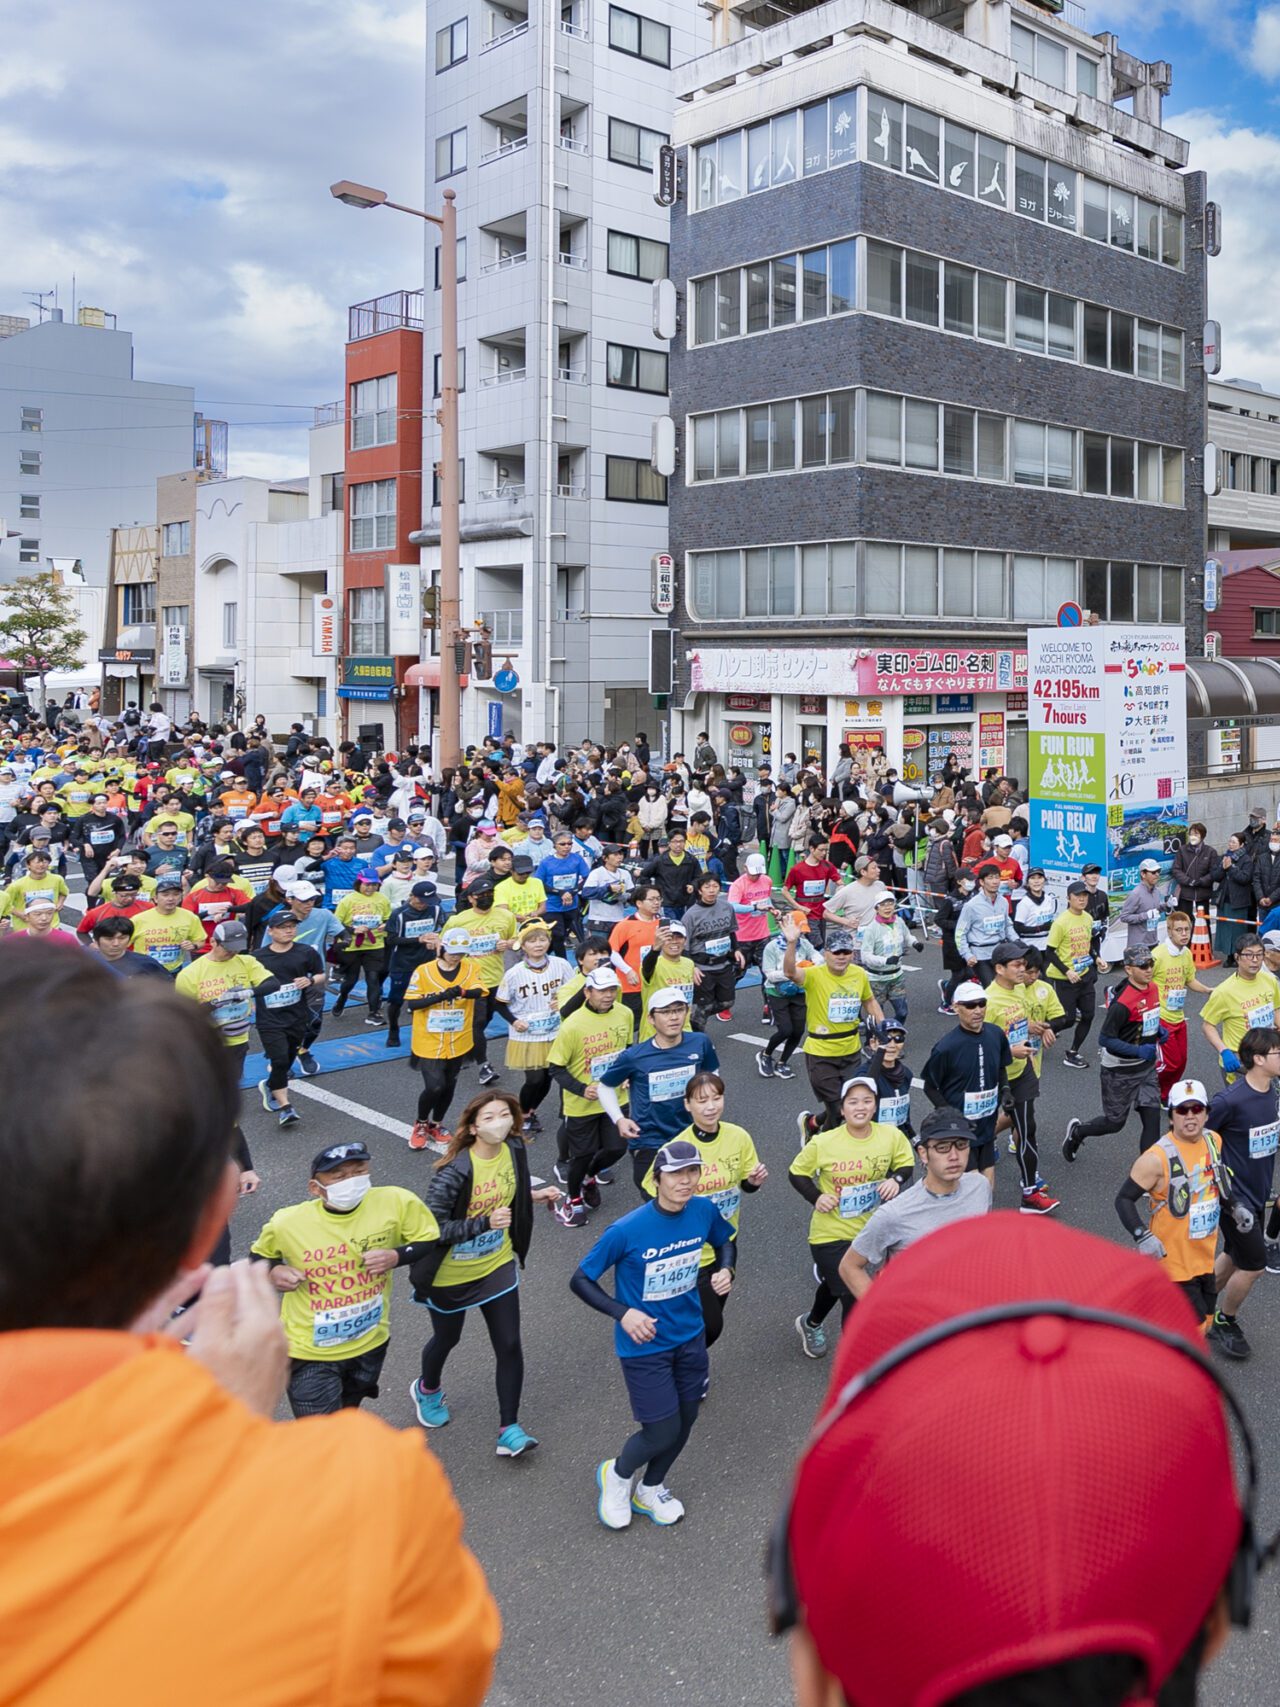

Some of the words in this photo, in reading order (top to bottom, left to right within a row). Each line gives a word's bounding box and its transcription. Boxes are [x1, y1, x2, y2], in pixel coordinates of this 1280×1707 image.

[1020, 197, 1076, 225] ヨガ・シャーラ
[660, 566, 670, 602] 三和電話
[322, 616, 332, 652] YAMAHA
[1041, 642, 1080, 652] WELCOME
[1082, 642, 1092, 652] TO
[877, 653, 994, 674] 実印・ゴム印・名刺
[1040, 654, 1064, 664] KOCHI
[1066, 654, 1094, 662] RYOMA
[1126, 658, 1164, 679] START
[1034, 679, 1100, 698] 42.195km
[1136, 685, 1168, 696] 高知銀行
[1135, 716, 1168, 726] 大旺新洋
[1040, 734, 1064, 755] FUN
[1066, 736, 1094, 757] RUN
[1158, 776, 1185, 799] 浦戸
[1041, 810, 1064, 830] PAIR
[1066, 812, 1096, 833] RELAY
[200, 978, 224, 988] 2024
[519, 978, 560, 999] Tiger
[1241, 998, 1260, 1010] 2024
[584, 1032, 608, 1044] 2024
[584, 1042, 613, 1055] KOCHI
[832, 1160, 862, 1172] 2024
[474, 1180, 497, 1196] 024
[697, 1178, 726, 1194] OCHI
[832, 1174, 868, 1185] KOCHI
[304, 1244, 347, 1262] 2024
[658, 1236, 702, 1256] phiten
[304, 1260, 356, 1280] KOCHI
[660, 1264, 698, 1285] 14674
[311, 1279, 388, 1310] MARATHON
[317, 1324, 328, 1336] G
[334, 1306, 382, 1332] 15642
